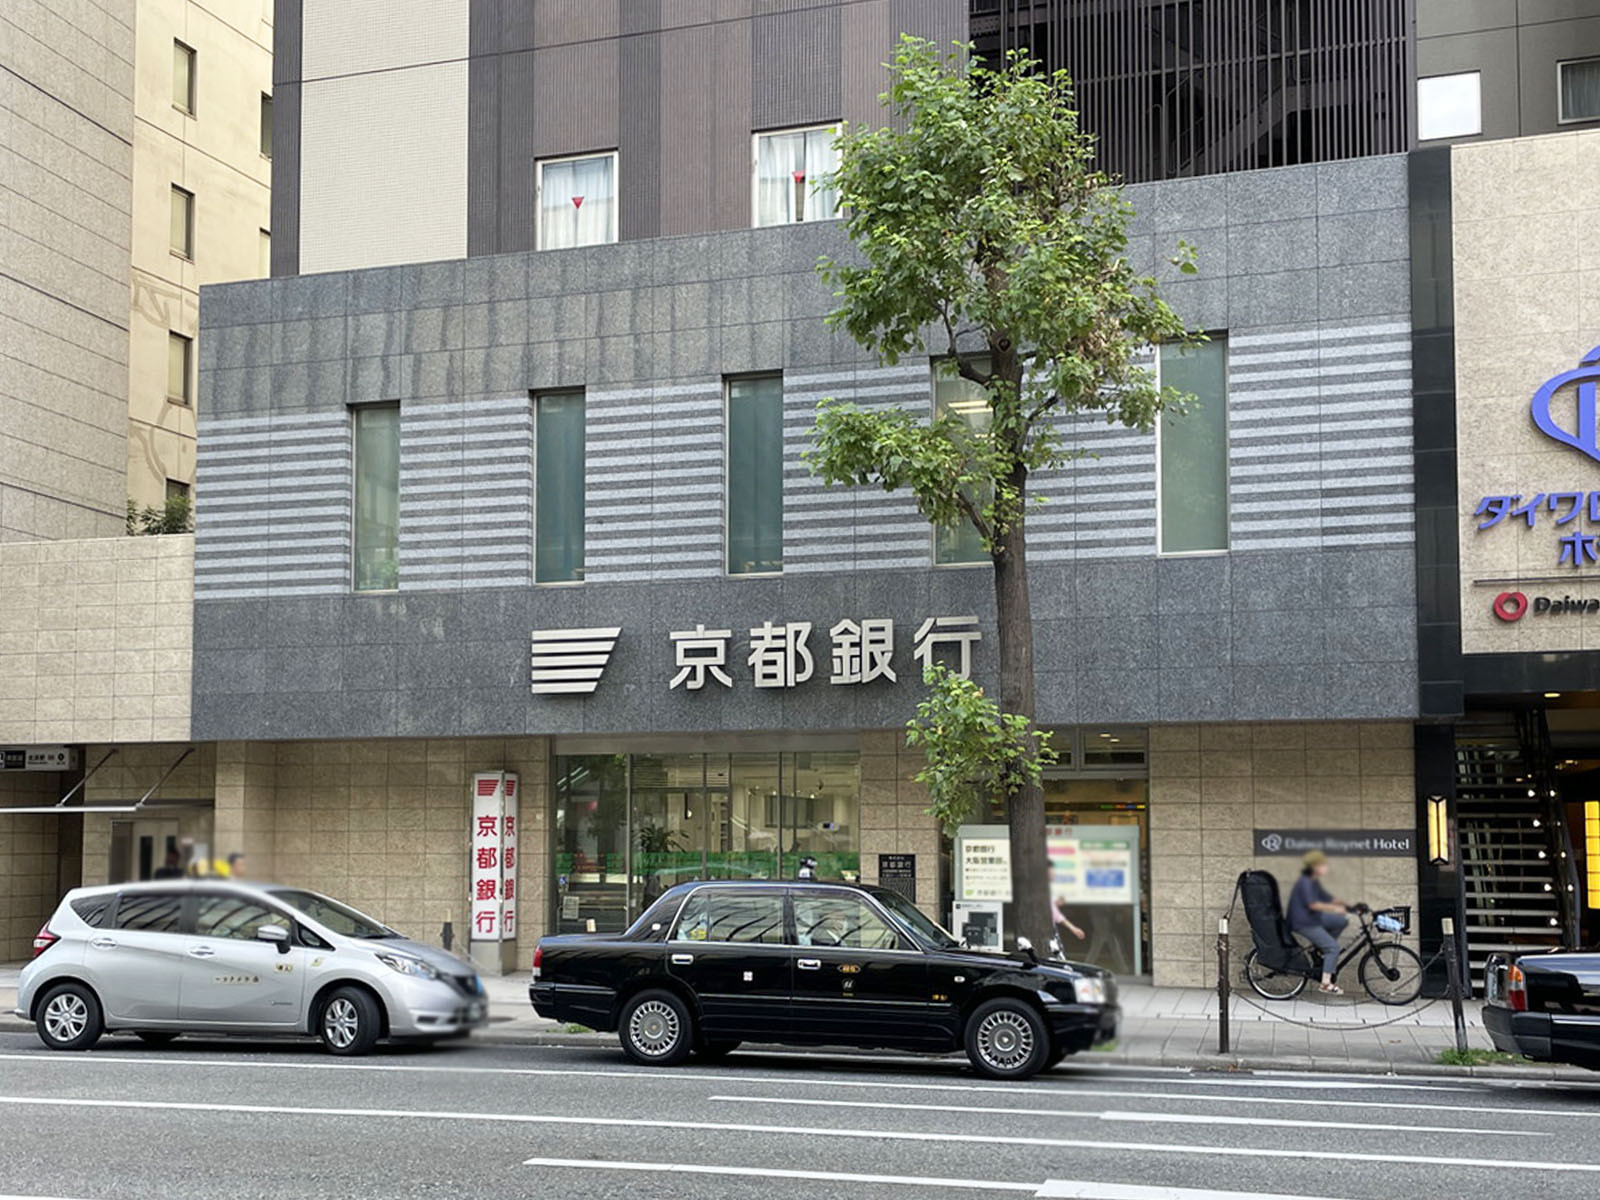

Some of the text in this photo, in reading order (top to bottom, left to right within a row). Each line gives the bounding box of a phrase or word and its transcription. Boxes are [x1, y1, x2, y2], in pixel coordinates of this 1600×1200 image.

[1559, 532, 1600, 566] ホ
[669, 616, 982, 690] 京都銀行
[476, 816, 498, 933] 京都銀行
[504, 816, 516, 933] 京都銀行
[1373, 838, 1410, 850] Hotel
